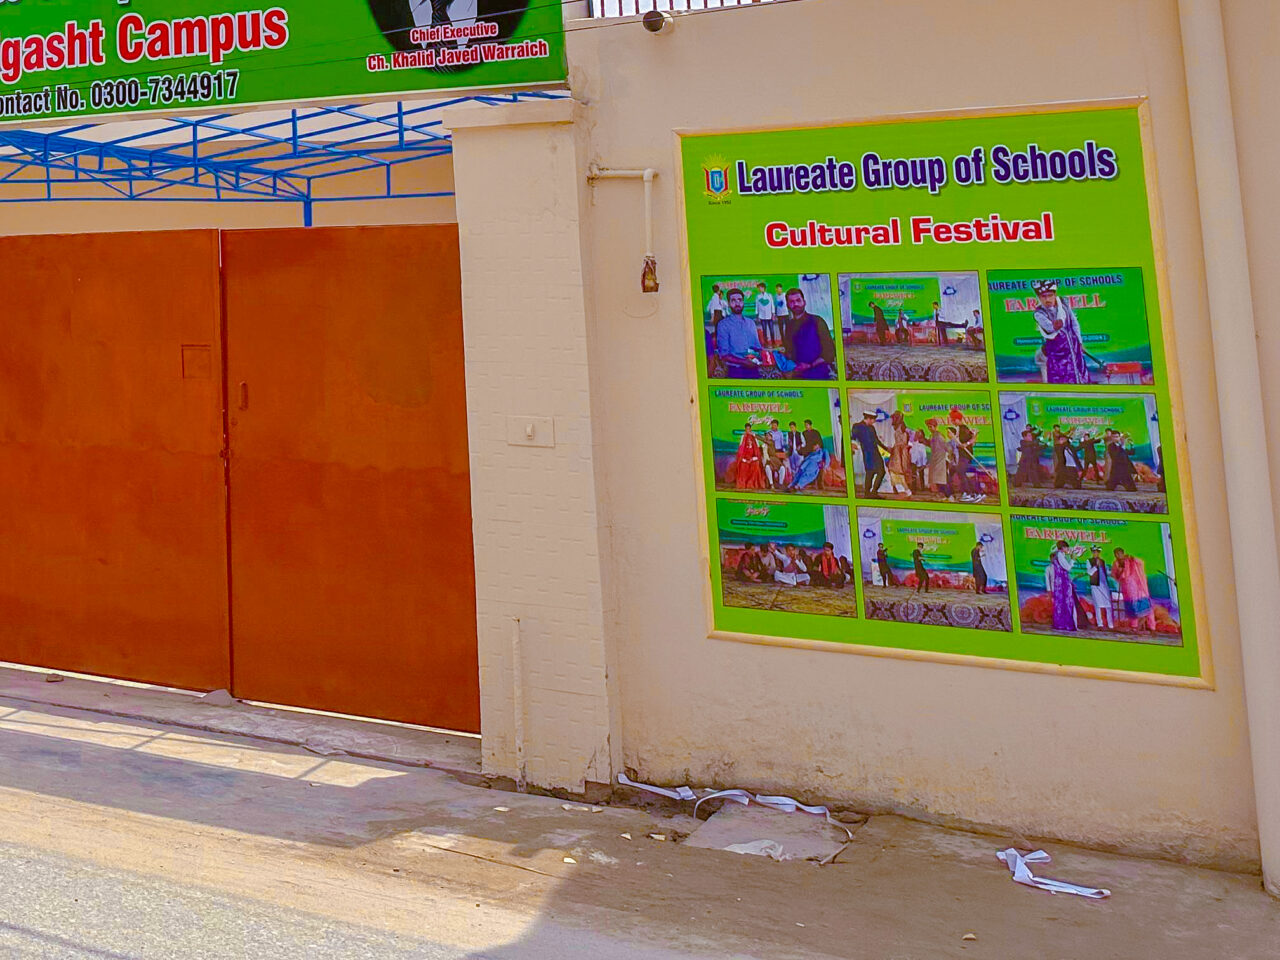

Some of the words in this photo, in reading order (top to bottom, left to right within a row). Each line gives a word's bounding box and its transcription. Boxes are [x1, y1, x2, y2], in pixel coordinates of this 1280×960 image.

[116, 6, 288, 66] Campus
[410, 28, 442, 44] Chief
[442, 22, 499, 40] Executive
[367, 54, 390, 72] Ch.
[392, 50, 435, 69] Khalid
[436, 45, 479, 66] Javed
[481, 39, 550, 63] Warraich
[56, 85, 86, 111] No.
[90, 69, 239, 107] 0300-7344917
[736, 156, 856, 196] Laureate
[861, 151, 947, 195] Group
[953, 146, 985, 185] of
[991, 140, 1118, 183] Schools
[765, 216, 902, 249] Cultural
[910, 211, 1055, 245] Festival
[1064, 278, 1077, 287] OF
[1079, 274, 1122, 286] SCHOOLS
